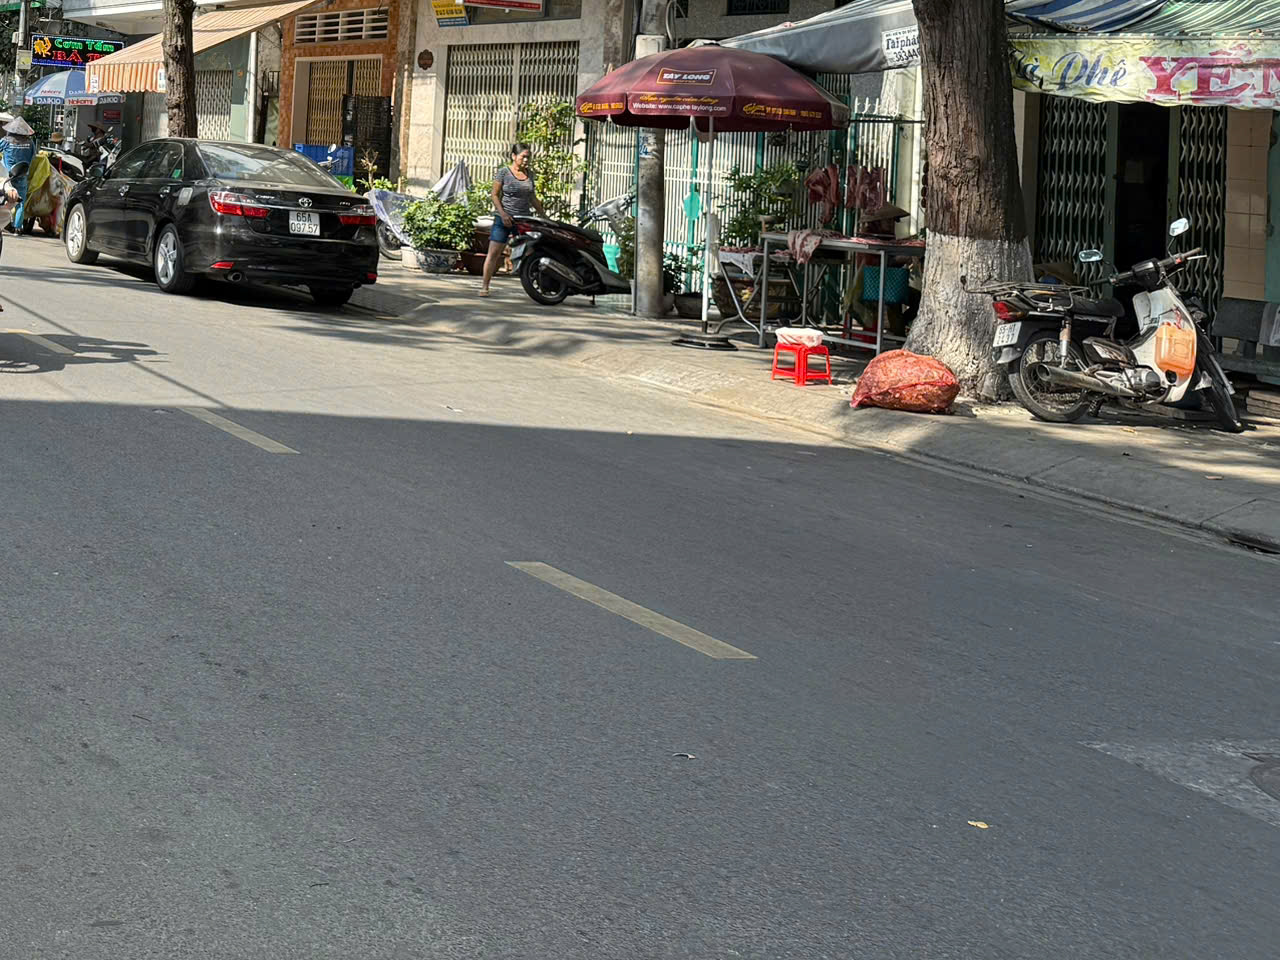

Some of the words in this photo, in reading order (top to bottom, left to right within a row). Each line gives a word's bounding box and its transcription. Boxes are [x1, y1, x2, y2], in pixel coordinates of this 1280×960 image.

[55, 39, 83, 50] Cơm
[86, 40, 114, 52] Tấm
[1052, 51, 1128, 90] Phê
[683, 73, 710, 81] LONG
[37, 97, 62, 105] DAIKIO
[296, 212, 312, 223] 65A
